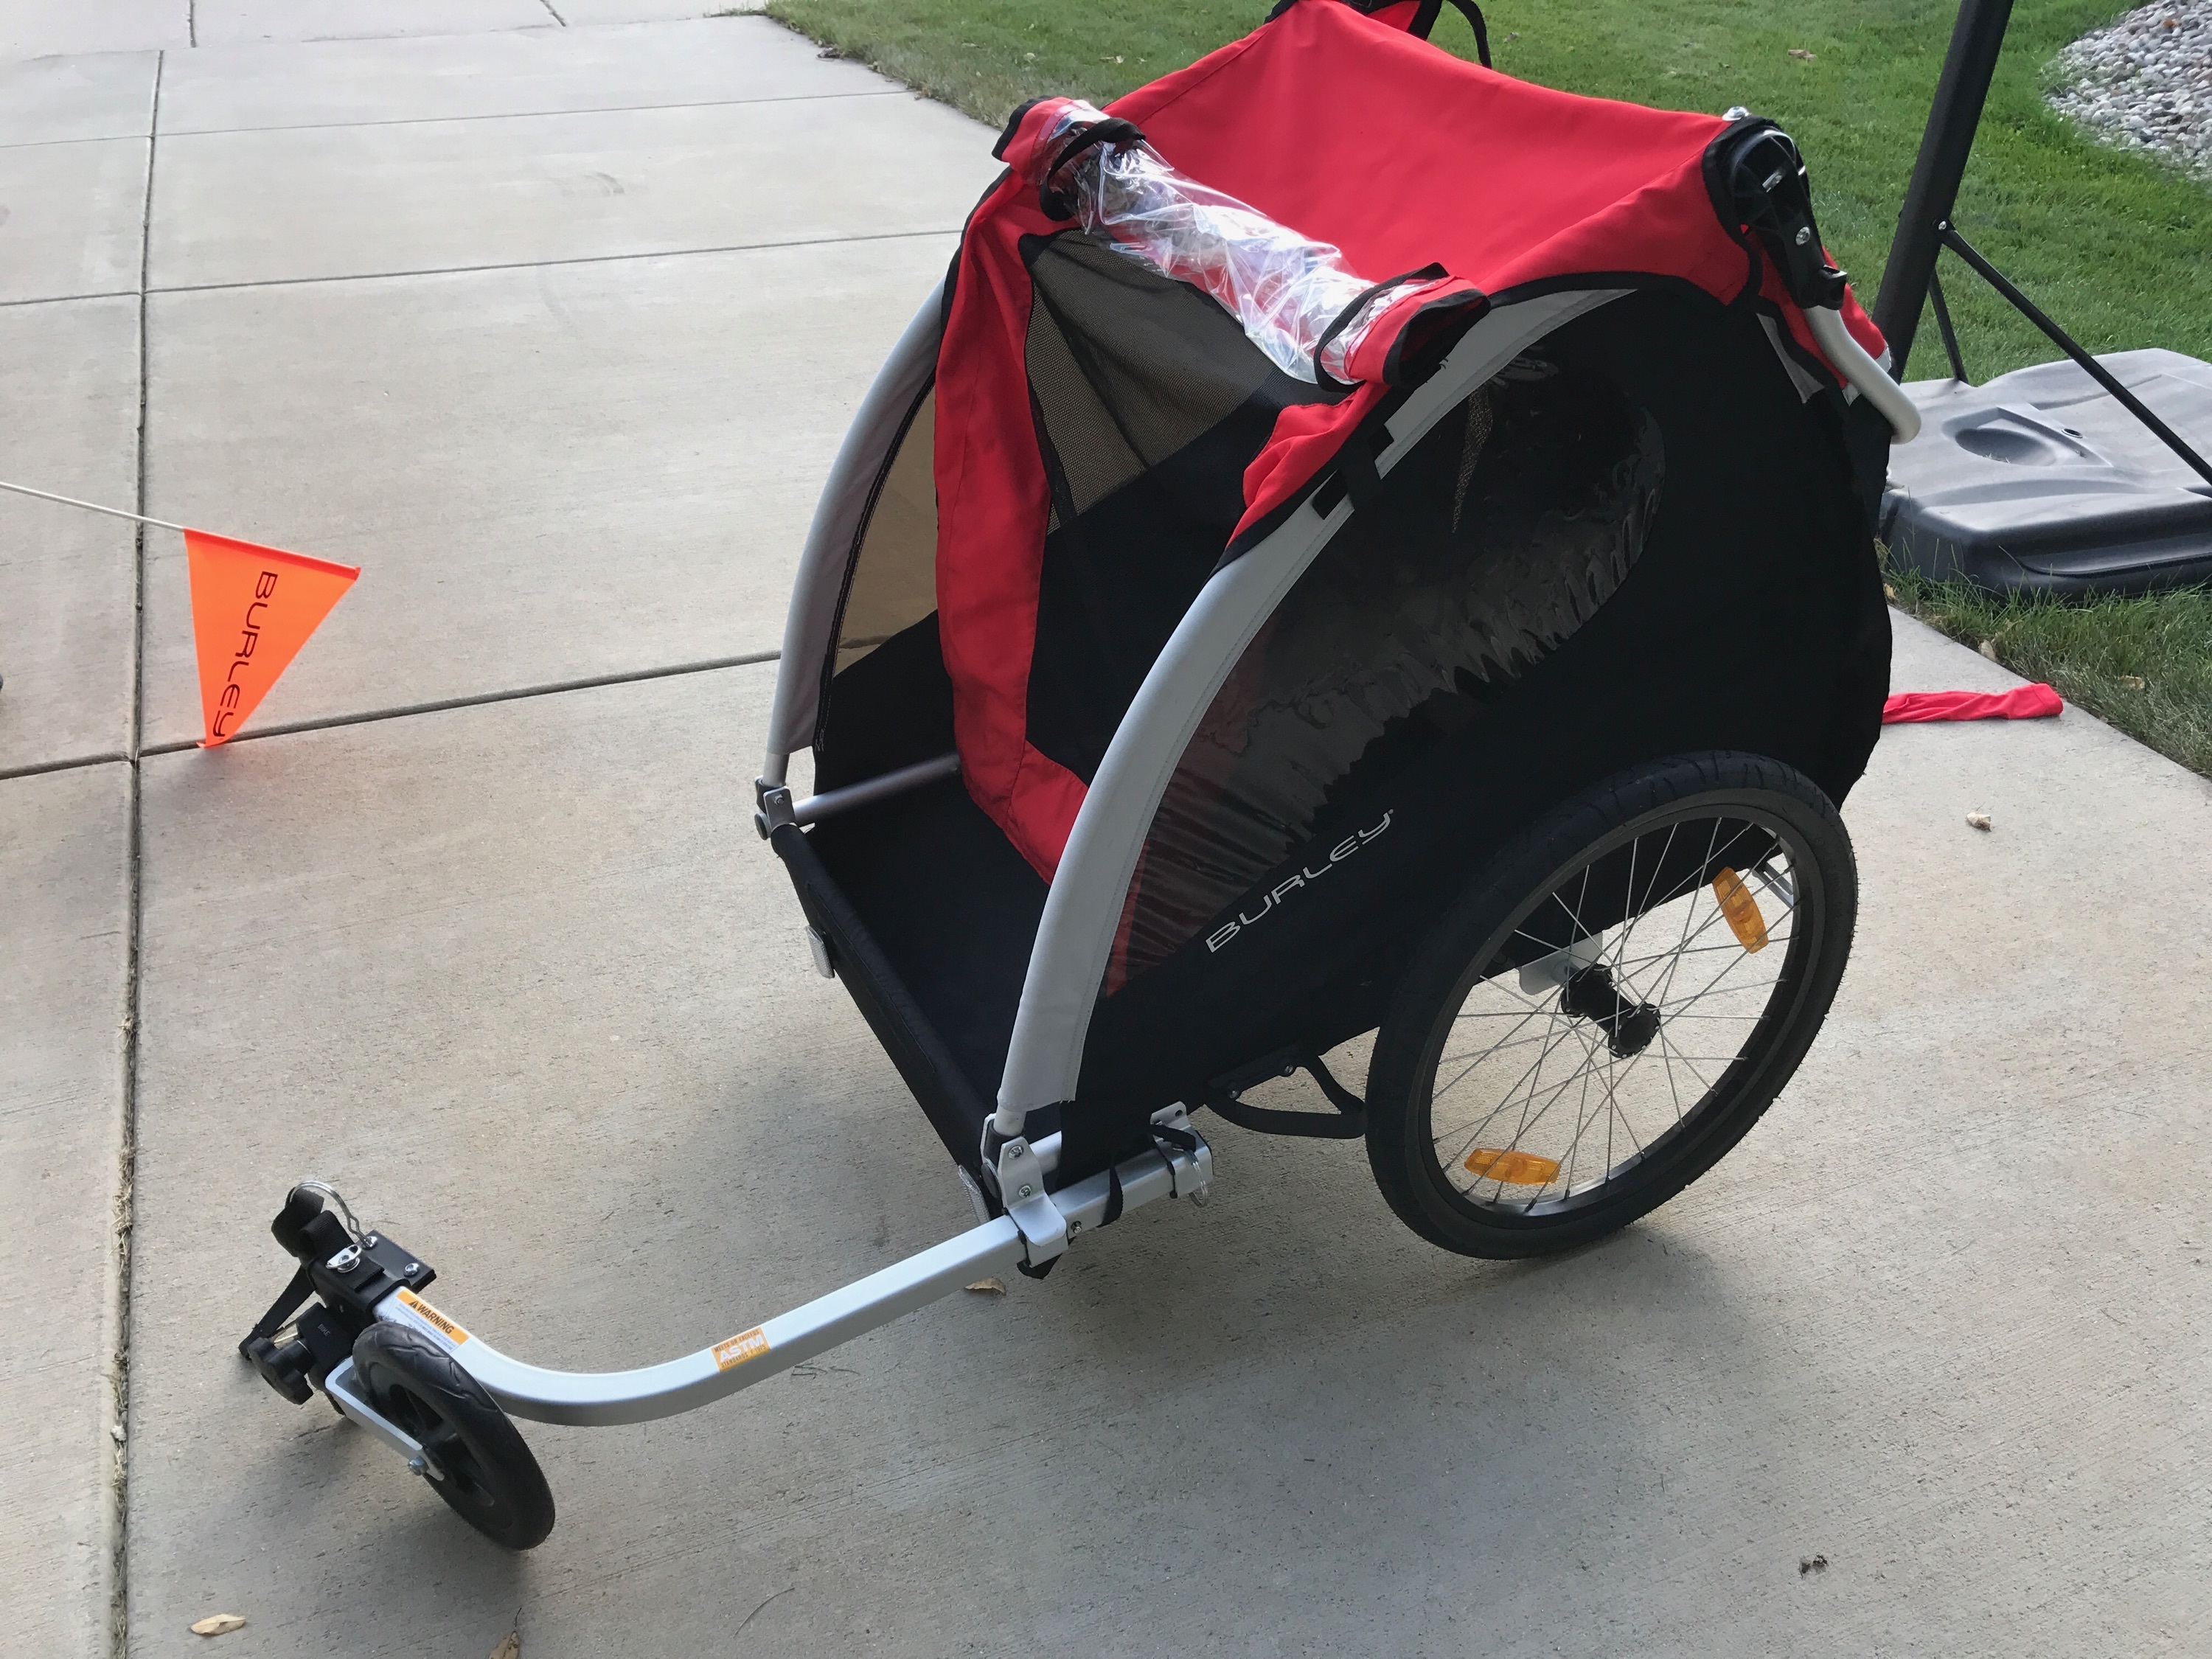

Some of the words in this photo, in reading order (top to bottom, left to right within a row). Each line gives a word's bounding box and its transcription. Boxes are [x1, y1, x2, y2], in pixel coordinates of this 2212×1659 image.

[212, 571, 278, 738] BURLEY
[1206, 811, 1391, 953] BURLEY
[317, 1324, 331, 1336] BIKE
[417, 1304, 455, 1334] WARNING
[714, 1342, 730, 1352] MEETS
[720, 1335, 765, 1363] ASTM
[720, 1352, 748, 1368] STANDARDS
